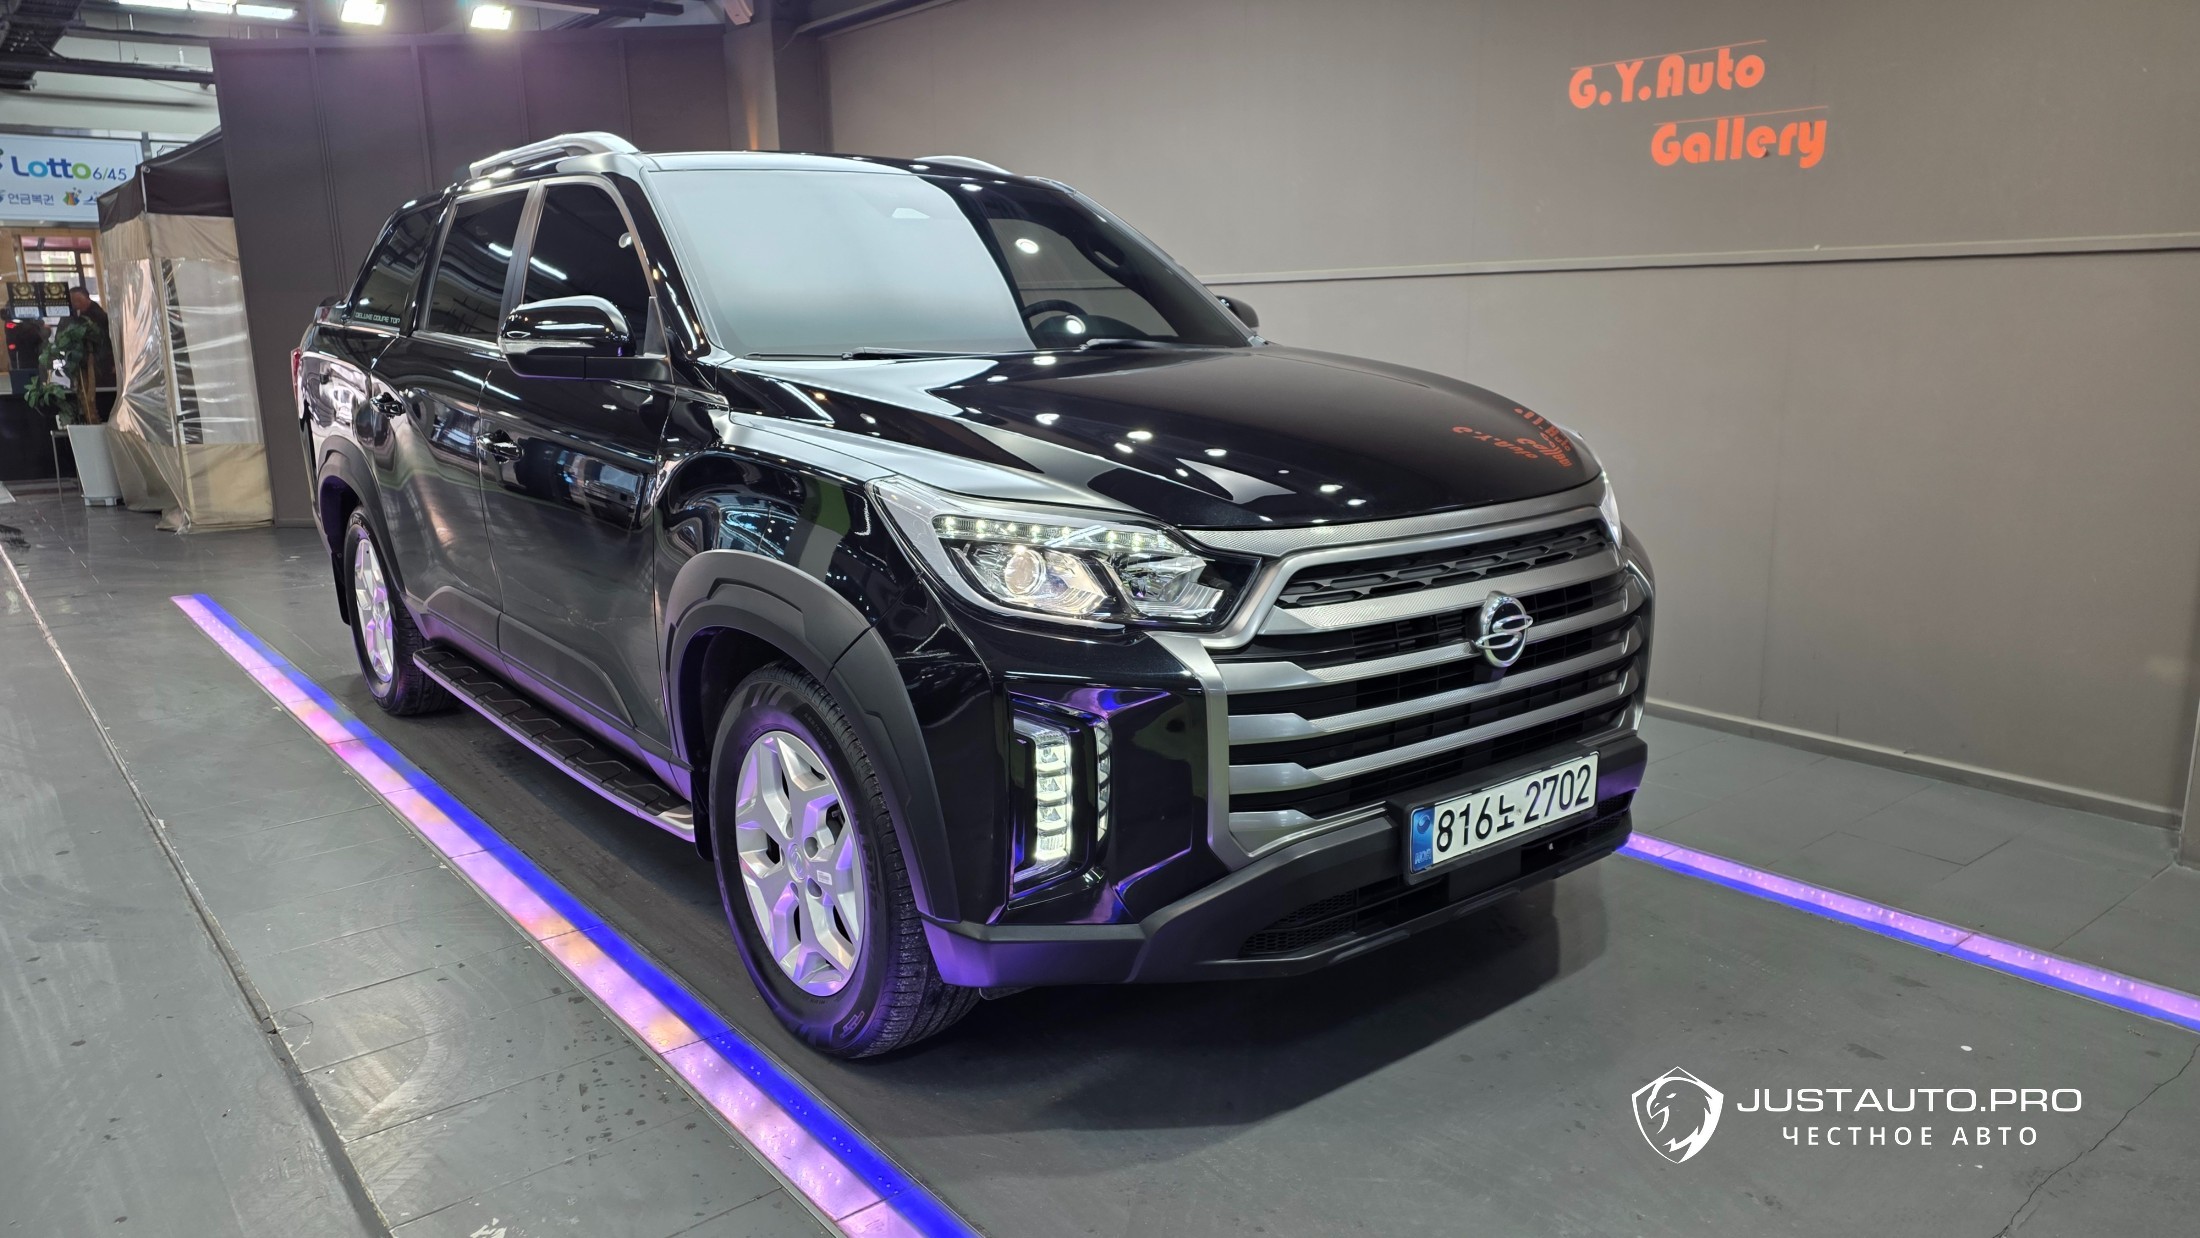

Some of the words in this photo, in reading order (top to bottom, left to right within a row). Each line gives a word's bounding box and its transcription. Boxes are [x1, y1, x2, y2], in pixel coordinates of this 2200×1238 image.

[1569, 48, 1765, 109] G.Y.Auto
[1651, 116, 1827, 169] Gallery
[11, 156, 91, 179] Lotto
[93, 167, 127, 181] 6/45
[8, 193, 54, 206] 연금복권
